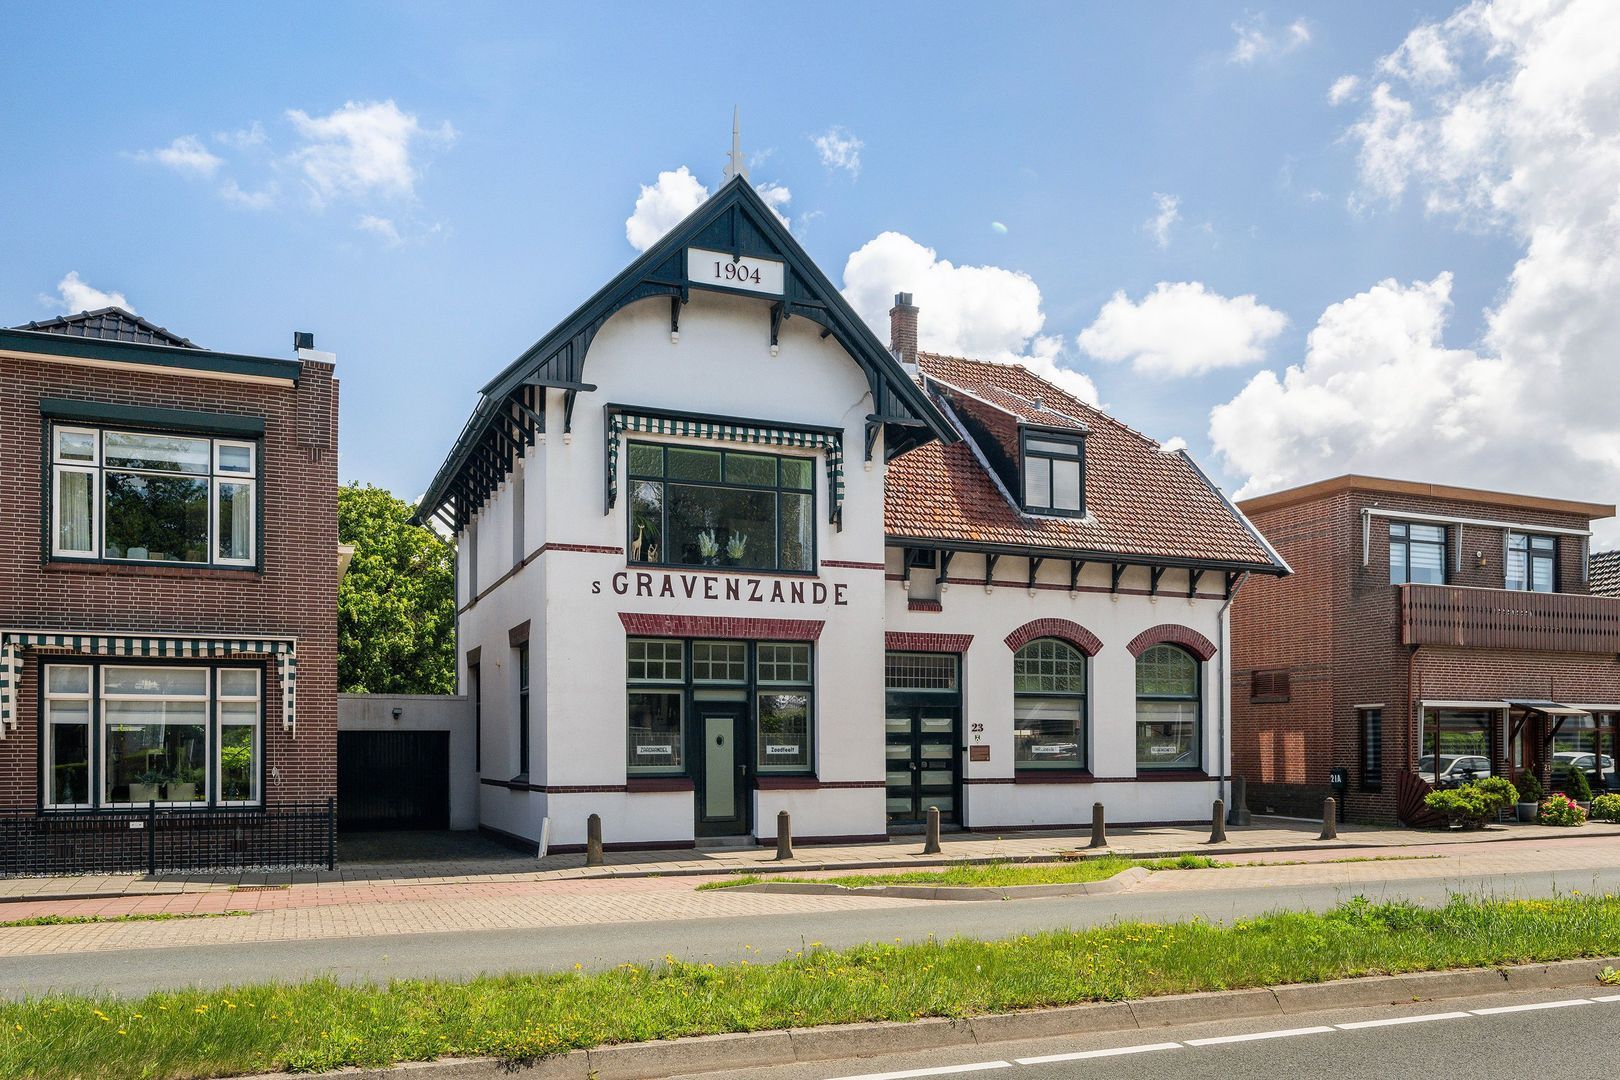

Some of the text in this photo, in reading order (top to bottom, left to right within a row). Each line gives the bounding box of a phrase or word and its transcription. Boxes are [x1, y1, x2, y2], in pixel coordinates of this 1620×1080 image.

[714, 261, 761, 284] 1904
[612, 572, 848, 606] GRAVENZANDE
[971, 723, 984, 732] 23
[1330, 774, 1342, 783] 21A
